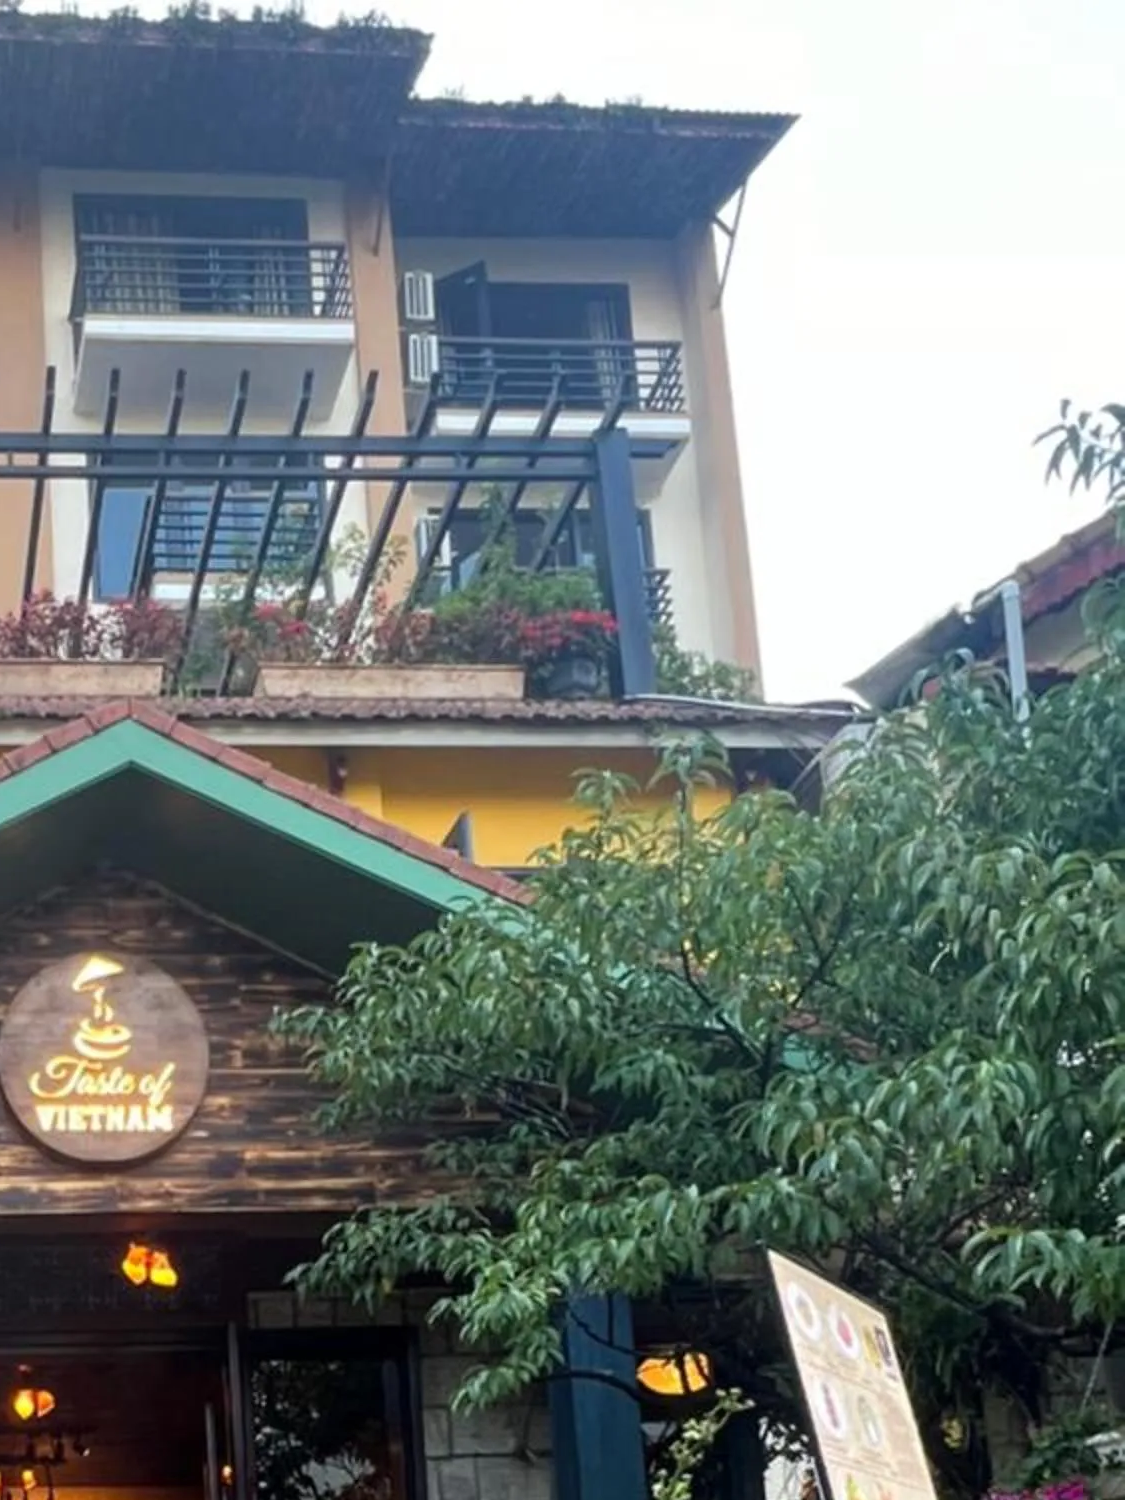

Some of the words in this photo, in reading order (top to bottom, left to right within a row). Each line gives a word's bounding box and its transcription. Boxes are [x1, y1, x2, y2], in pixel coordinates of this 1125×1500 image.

[29, 1055, 136, 1099] Taste
[139, 1061, 175, 1105] of
[35, 1103, 173, 1132] VIETNAM
